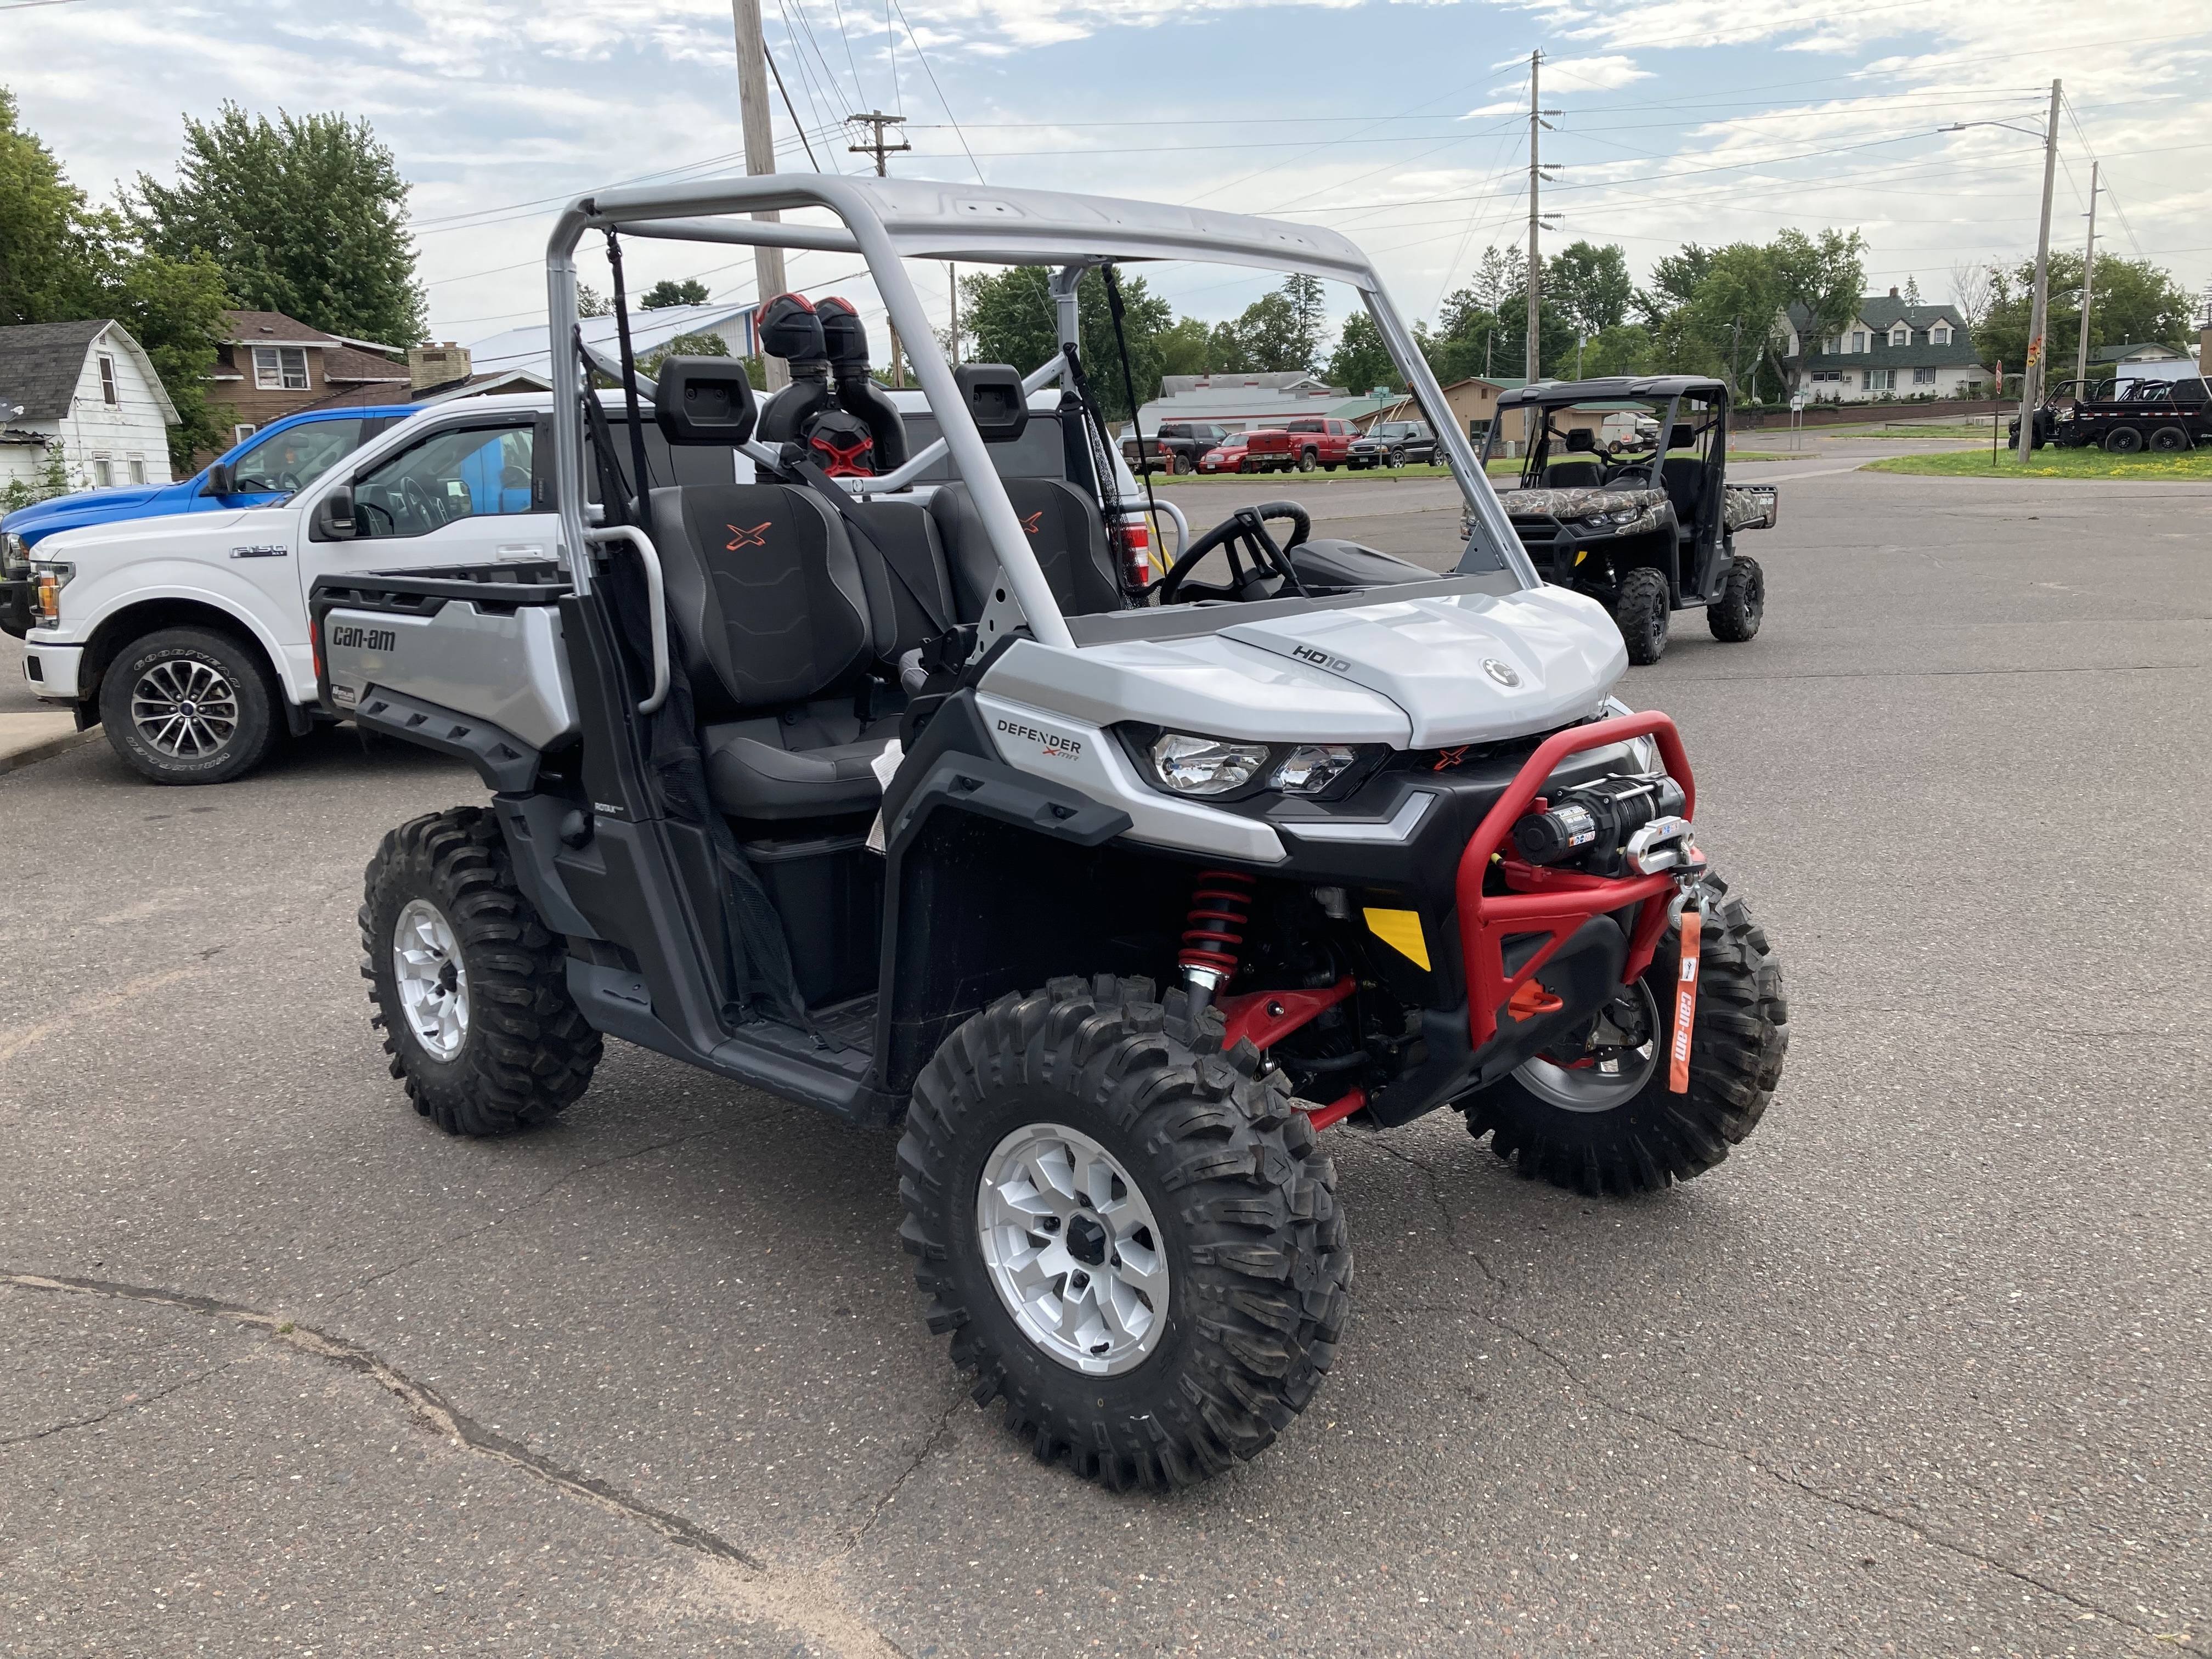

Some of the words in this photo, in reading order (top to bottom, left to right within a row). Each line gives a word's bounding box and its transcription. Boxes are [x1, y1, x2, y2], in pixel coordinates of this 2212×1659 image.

[333, 626, 396, 652] can-am
[133, 648, 241, 689] GOODYEAR
[1292, 645, 1351, 673] HD10
[126, 736, 236, 771] WRANGLER
[997, 719, 1081, 754] DEFENDER
[1558, 807, 1586, 817] can-am
[1674, 991, 1692, 1062] can-am
